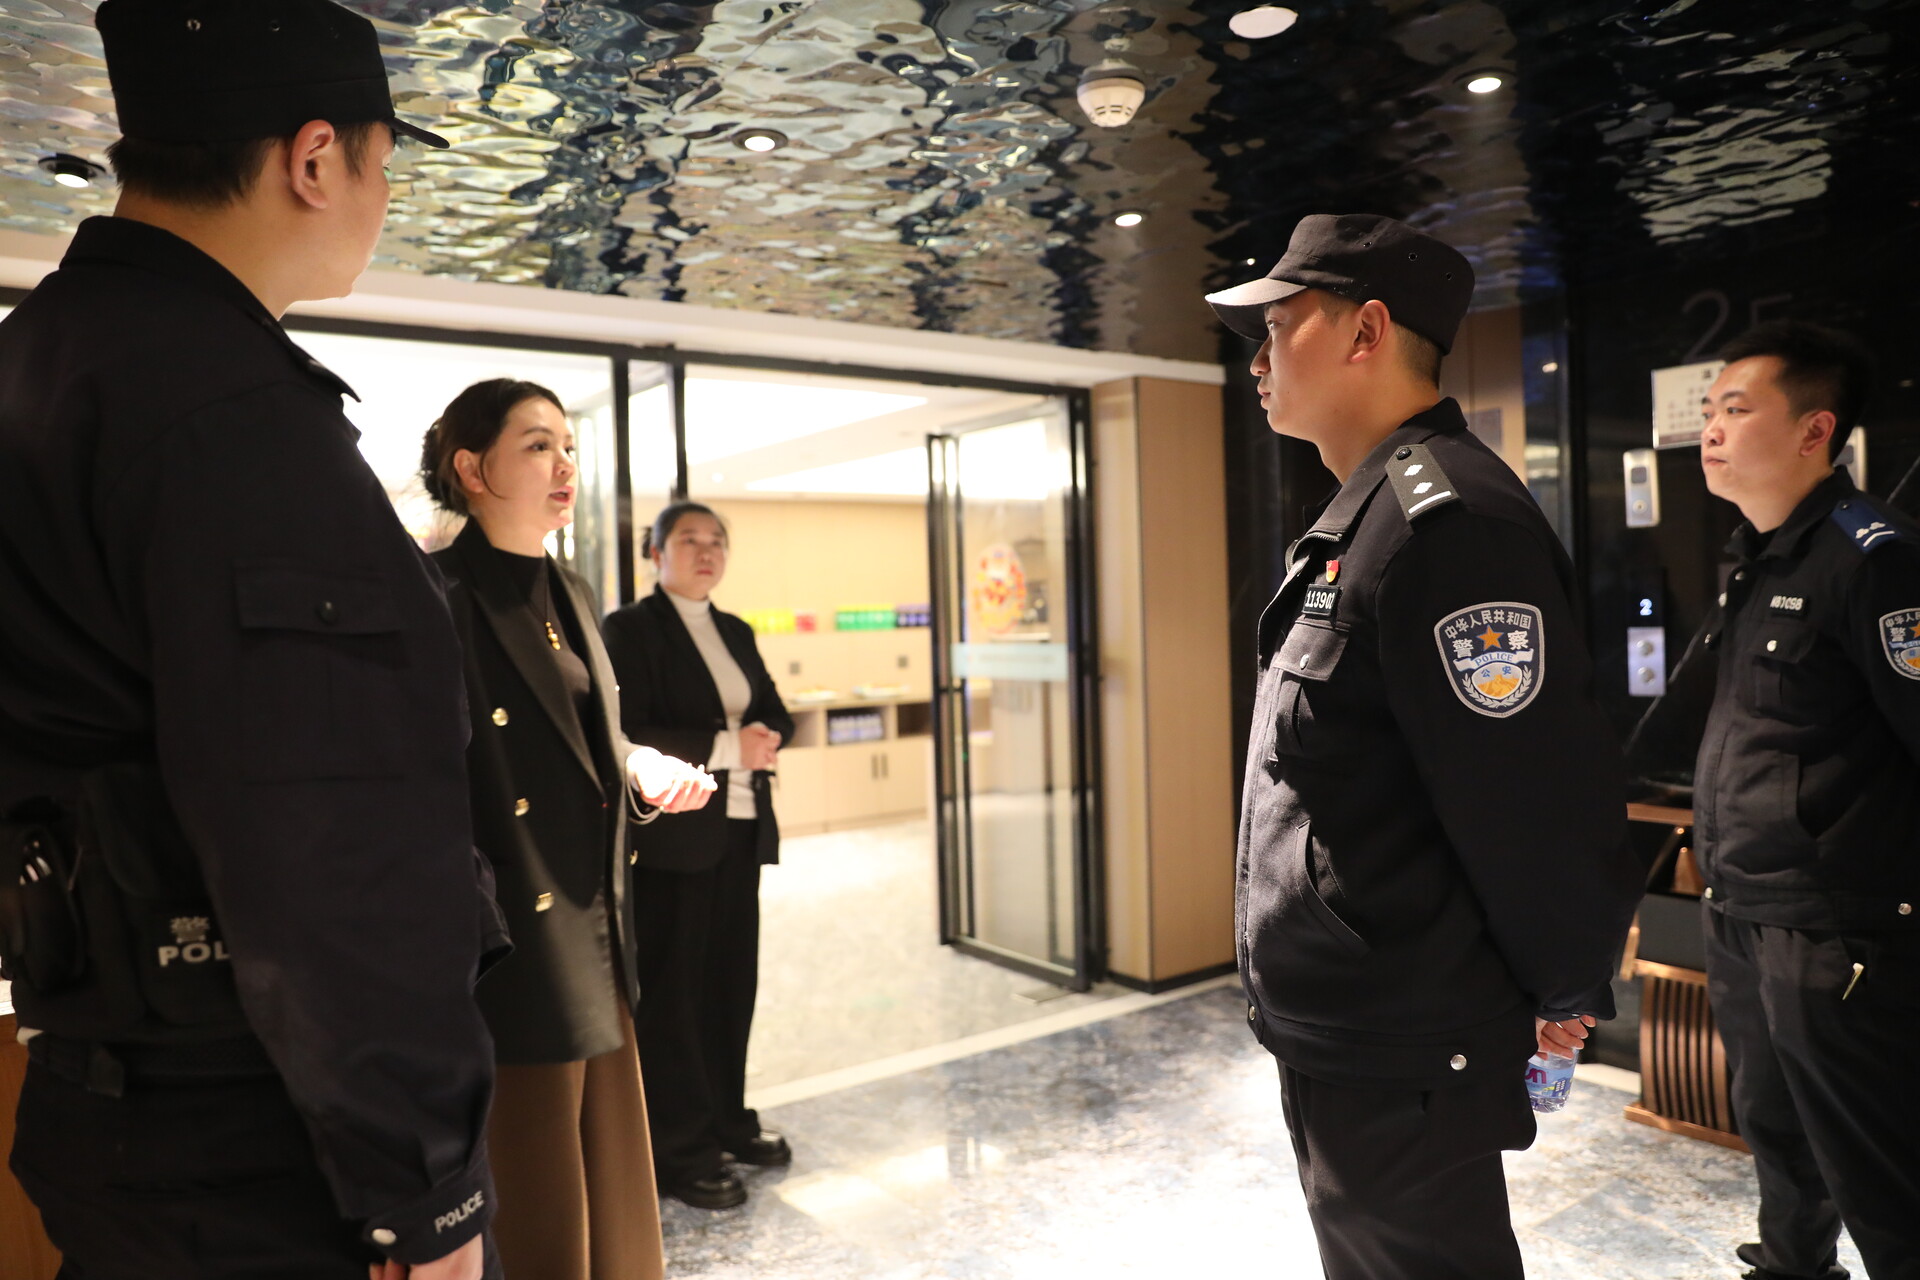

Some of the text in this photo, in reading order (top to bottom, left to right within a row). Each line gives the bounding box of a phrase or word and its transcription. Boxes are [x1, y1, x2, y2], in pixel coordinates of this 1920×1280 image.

[1639, 598, 1653, 616] 2
[1444, 609, 1532, 639] 中华人民共和国
[1452, 630, 1529, 658] 警 察
[1474, 653, 1514, 667] POLICE
[434, 1190, 484, 1234] POLICE
